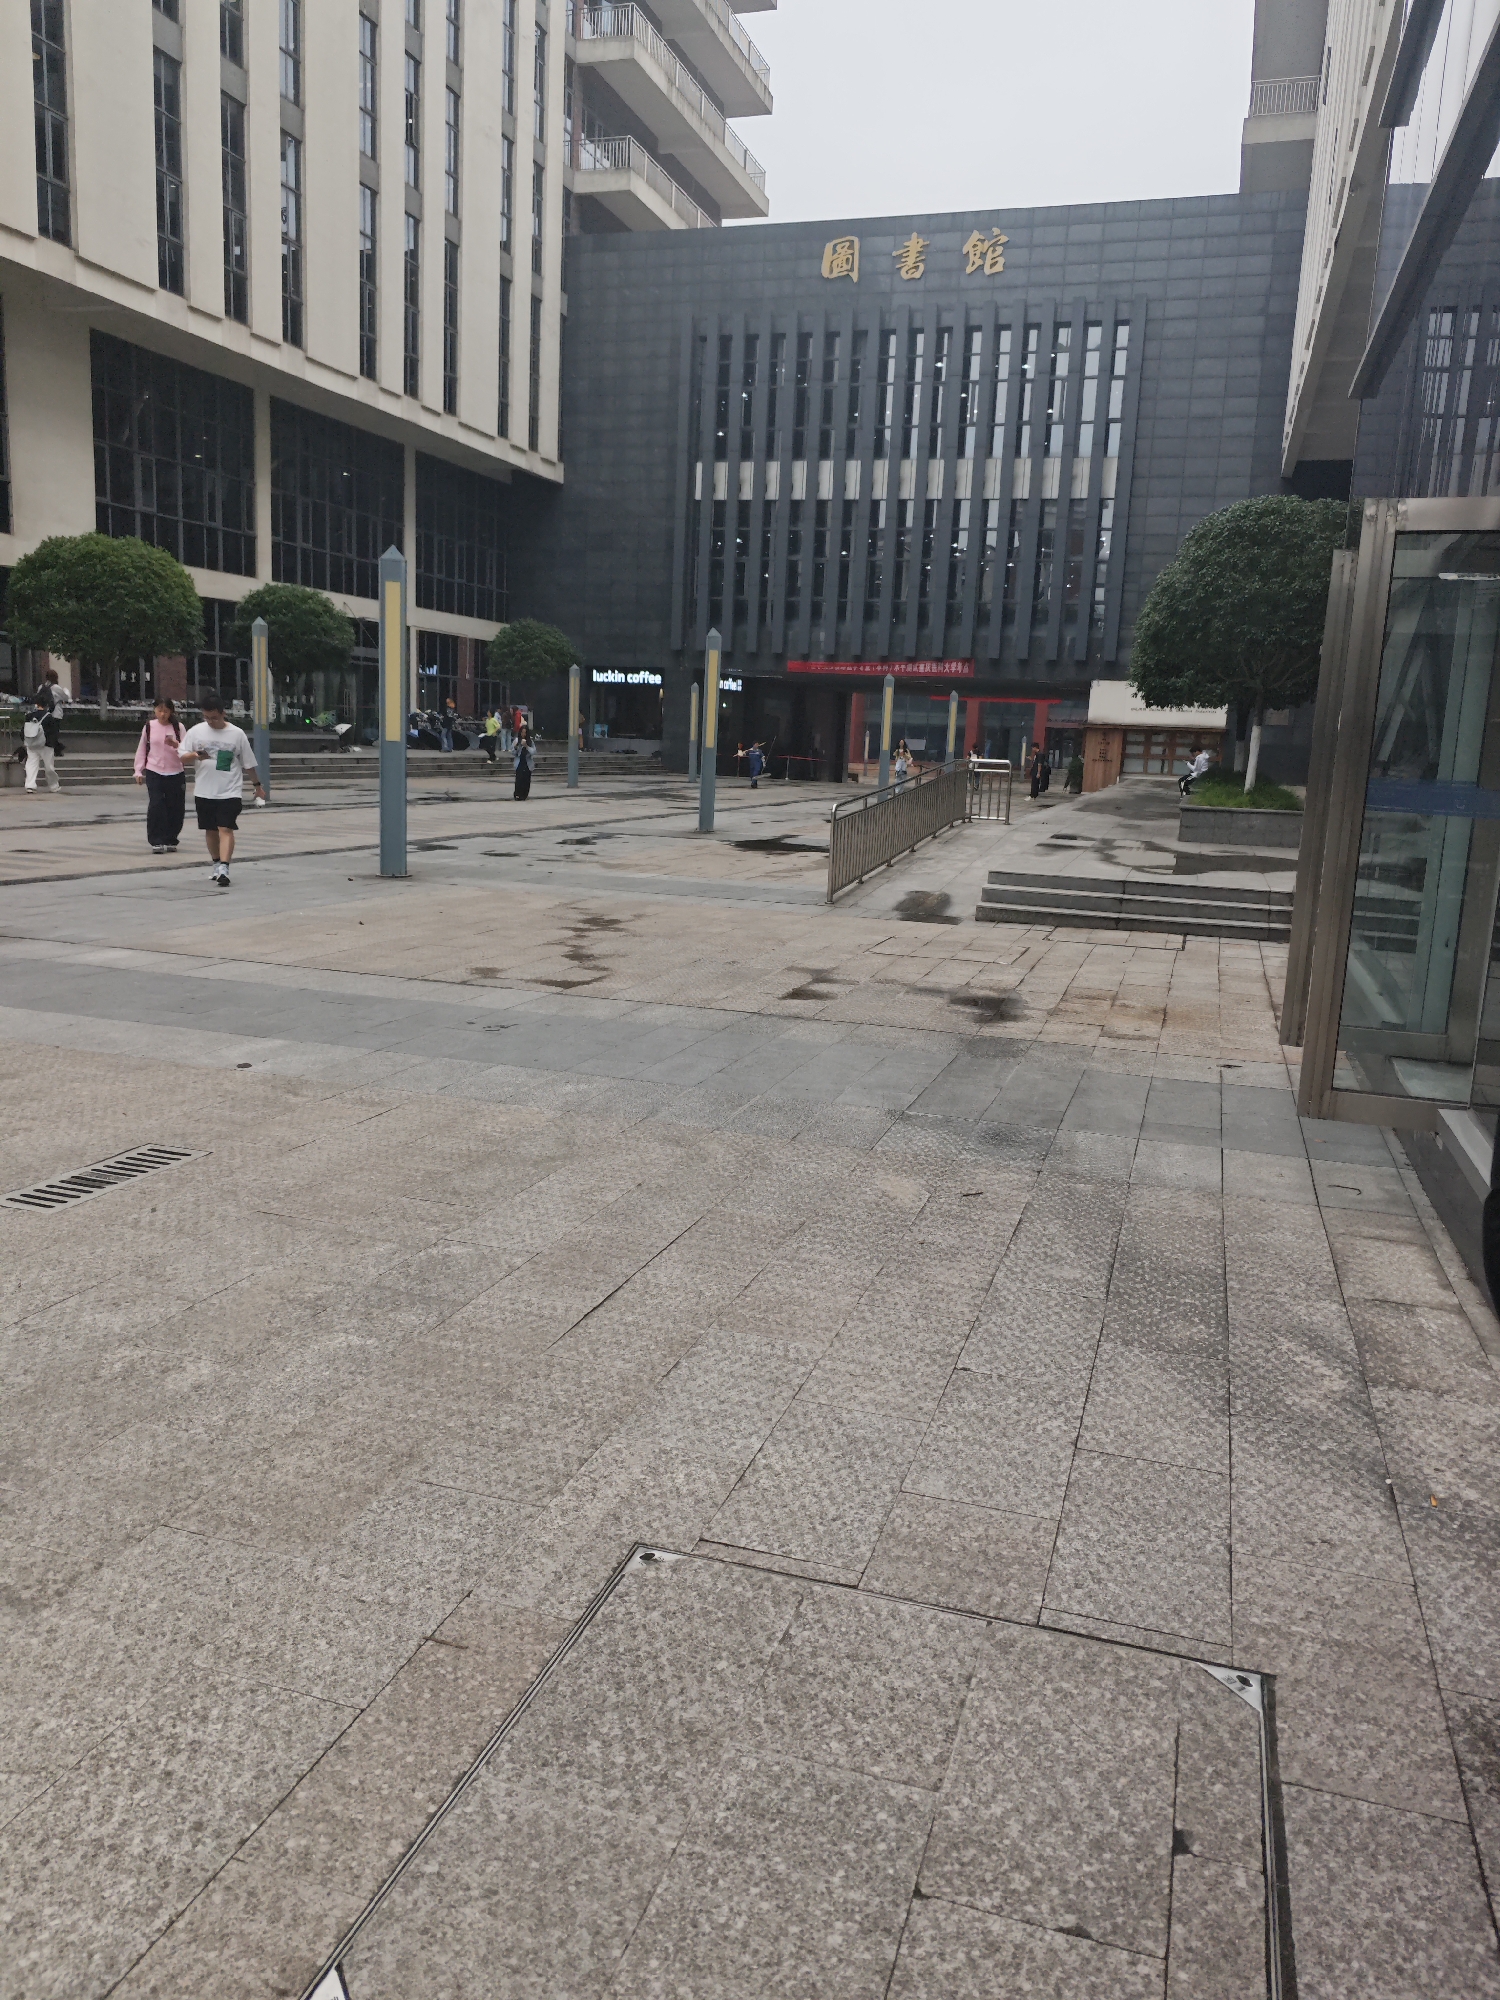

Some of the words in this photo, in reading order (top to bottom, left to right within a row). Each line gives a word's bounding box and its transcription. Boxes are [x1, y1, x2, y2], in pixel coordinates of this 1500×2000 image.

[821, 227, 1010, 284] 圖書館
[592, 668, 626, 683] luckin
[626, 670, 662, 685] coffee
